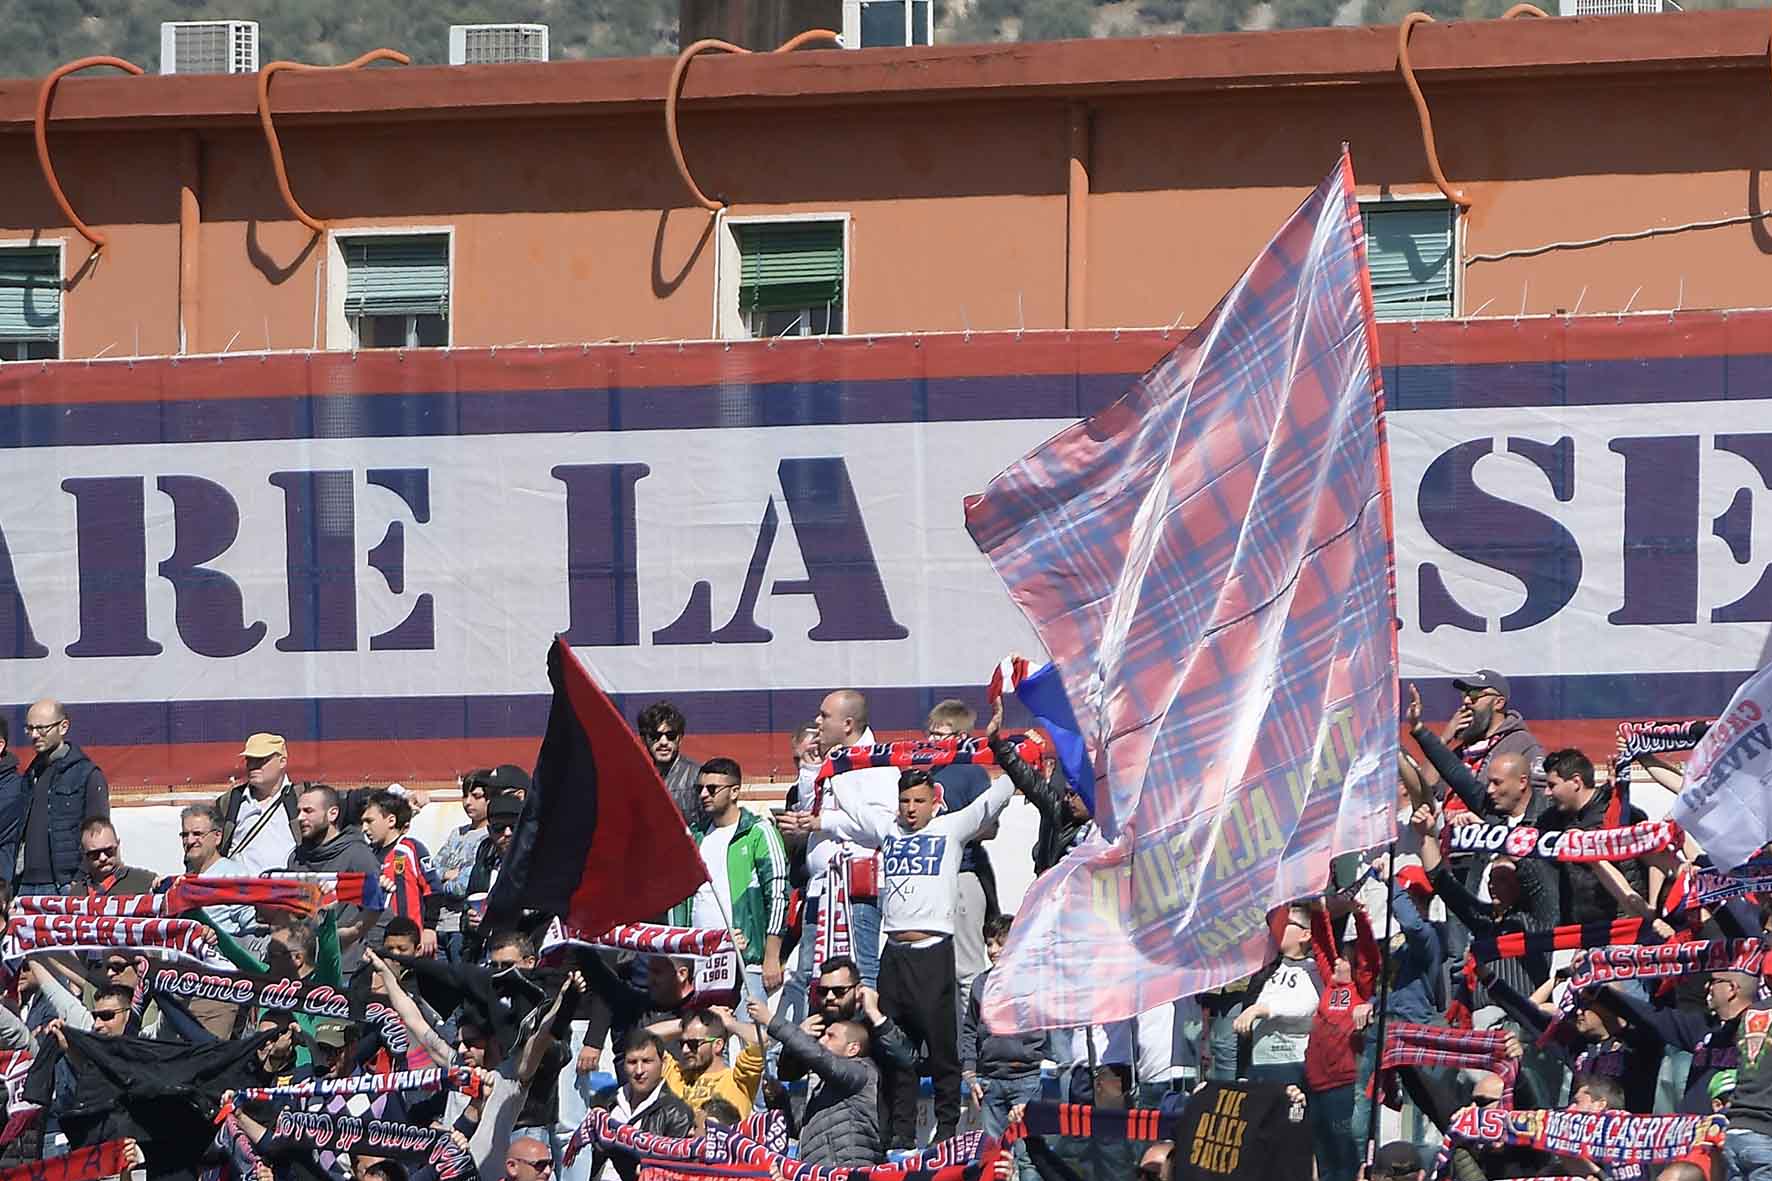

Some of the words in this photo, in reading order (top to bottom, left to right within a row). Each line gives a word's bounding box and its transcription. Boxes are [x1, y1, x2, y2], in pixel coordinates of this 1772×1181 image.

[550, 455, 909, 646] LA
[1214, 1087, 1248, 1118] THE
[1195, 1111, 1248, 1148] BLACK
[1188, 1137, 1241, 1175] SHEEP
